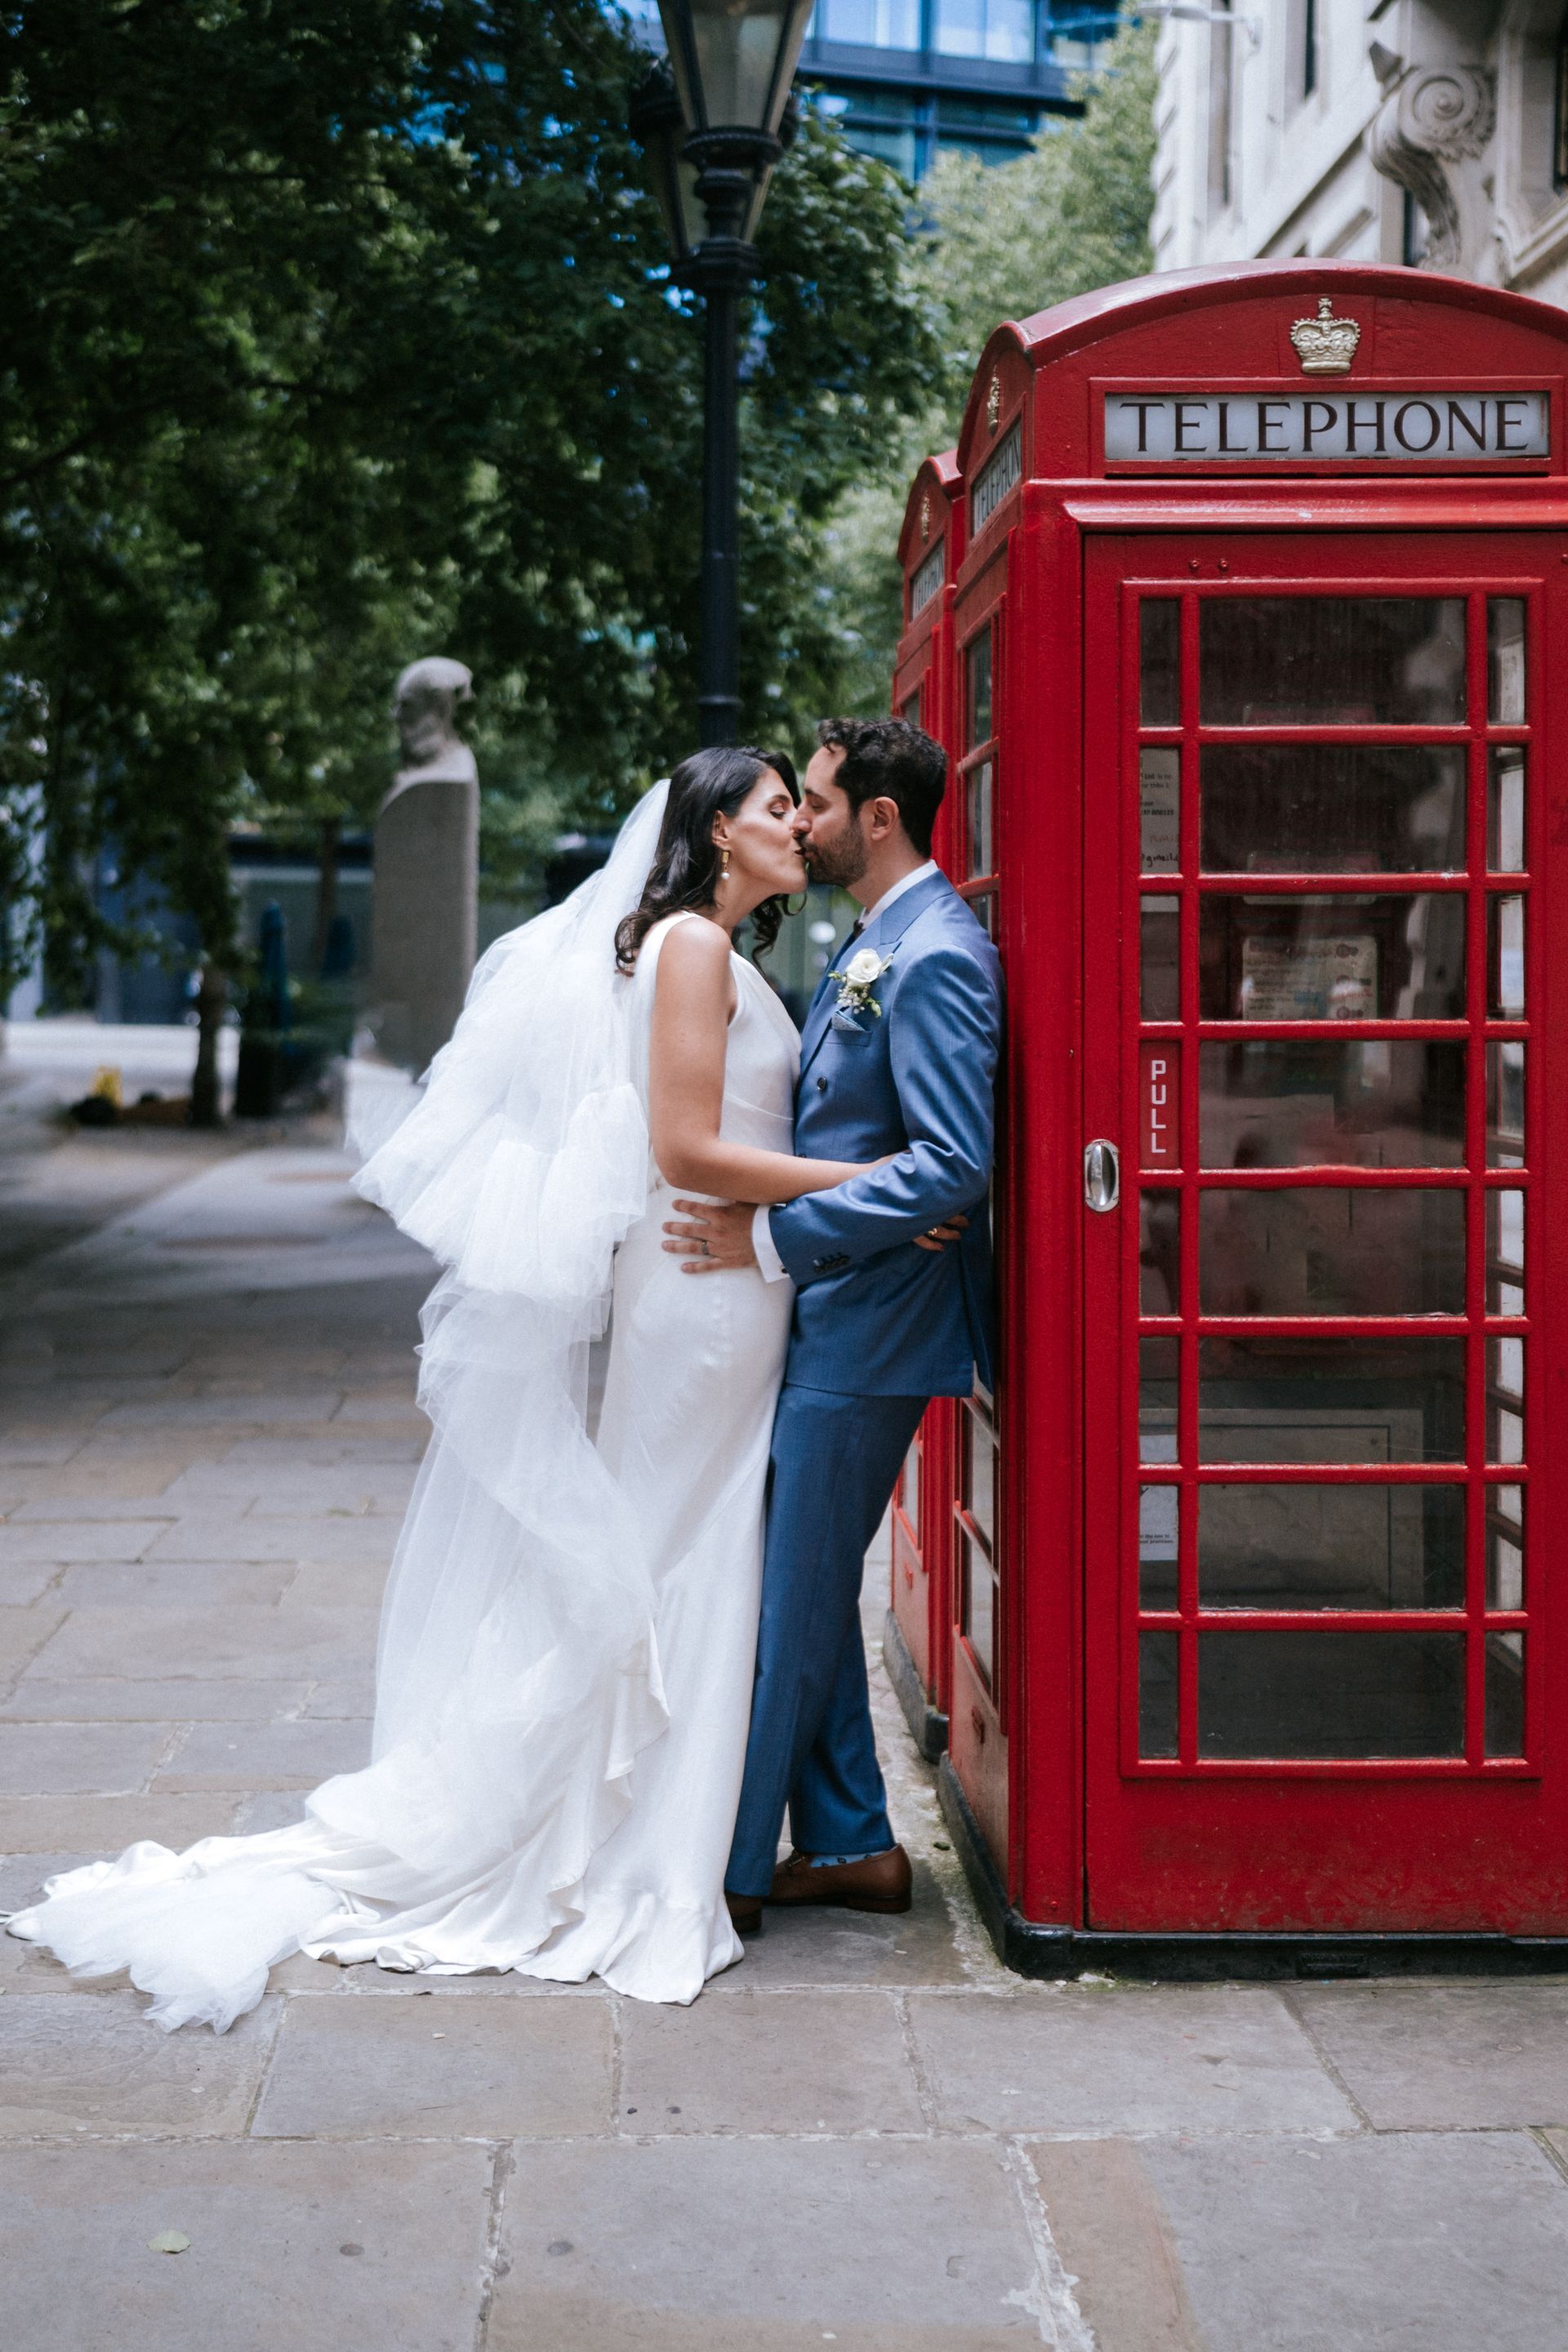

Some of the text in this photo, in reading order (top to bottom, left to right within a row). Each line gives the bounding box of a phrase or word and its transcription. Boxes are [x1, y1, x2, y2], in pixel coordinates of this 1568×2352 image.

[1120, 399, 1529, 452] TELEPHONE
[975, 430, 1021, 529] TELEPHON
[1151, 1059, 1167, 1154] PULL
